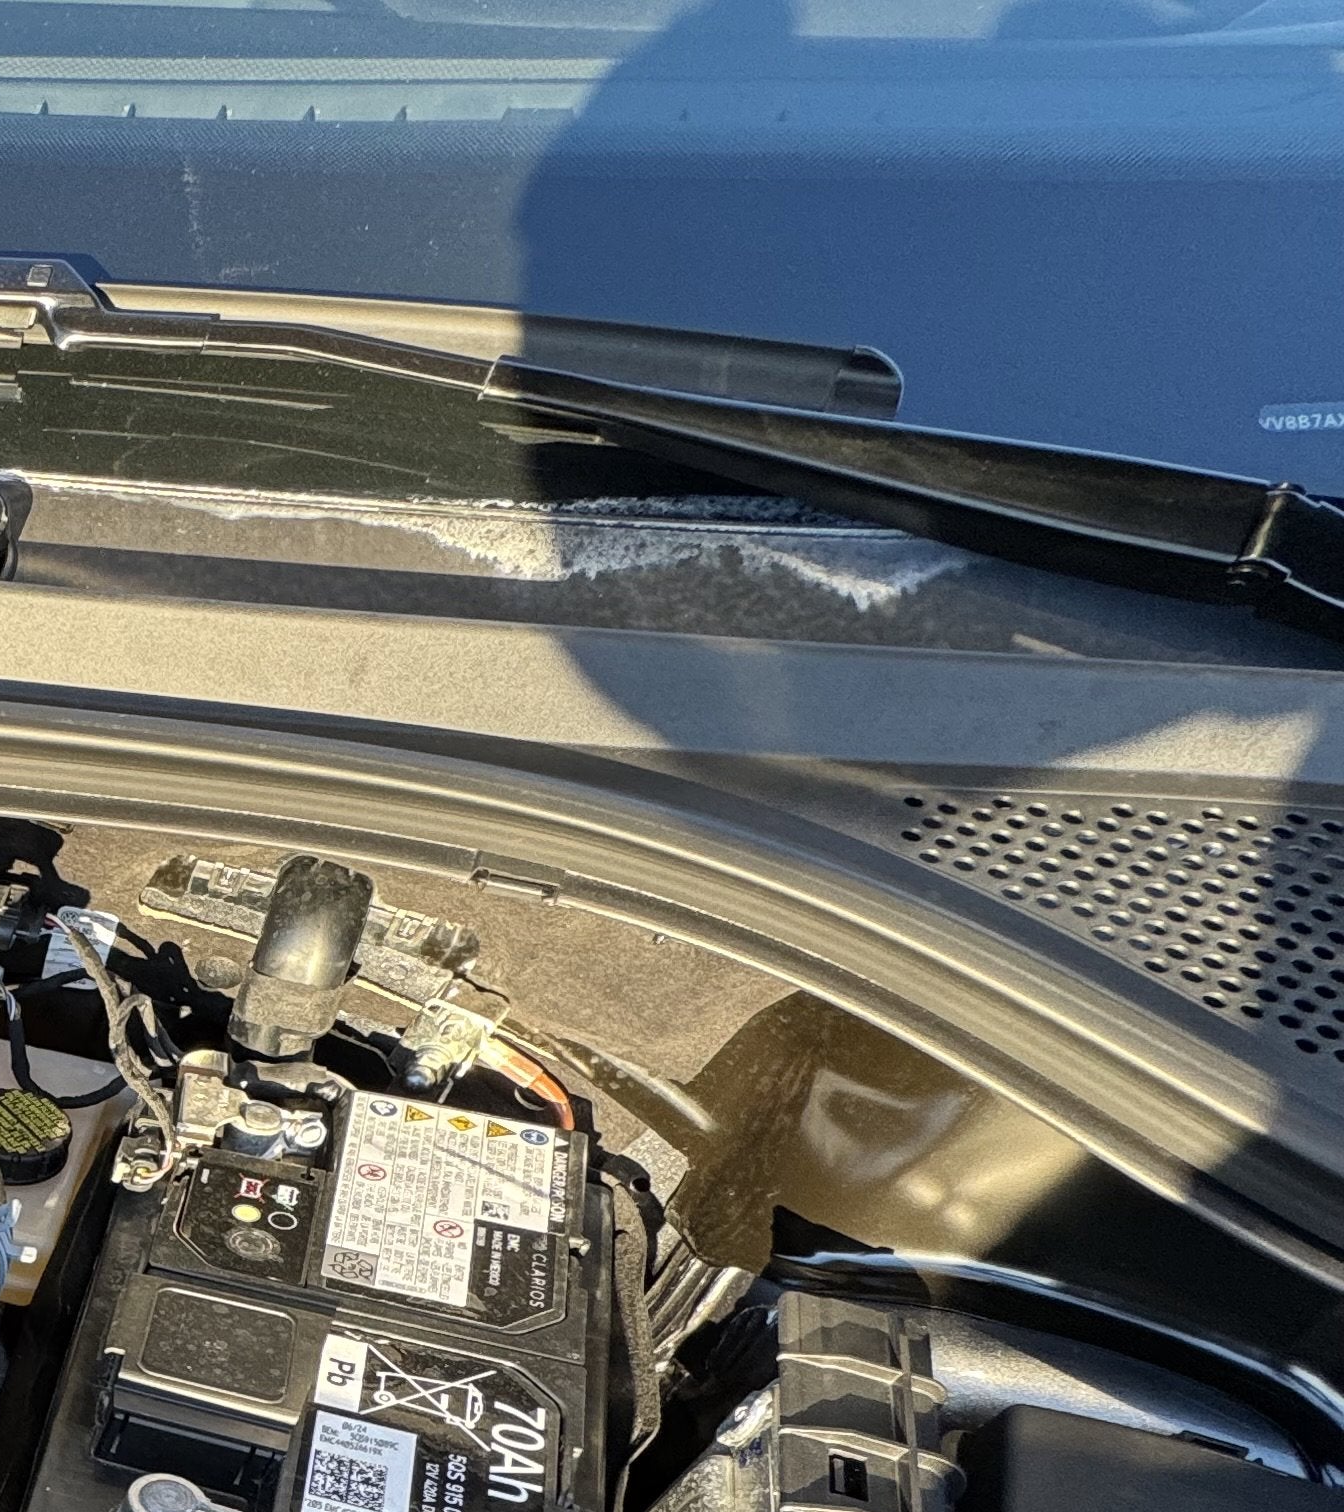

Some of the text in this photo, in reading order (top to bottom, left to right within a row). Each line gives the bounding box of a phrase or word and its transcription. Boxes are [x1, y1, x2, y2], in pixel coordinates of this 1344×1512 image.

[487, 1231, 502, 1286] MADE IN MEXICO
[529, 1254, 546, 1308] CLARIOS
[326, 1357, 356, 1388] Pb
[487, 1402, 546, 1502] 70Ah
[424, 1462, 438, 1478] 12V
[447, 1454, 466, 1481] 5QS
[422, 1478, 437, 1503] 420A
[444, 1482, 463, 1505] 915
